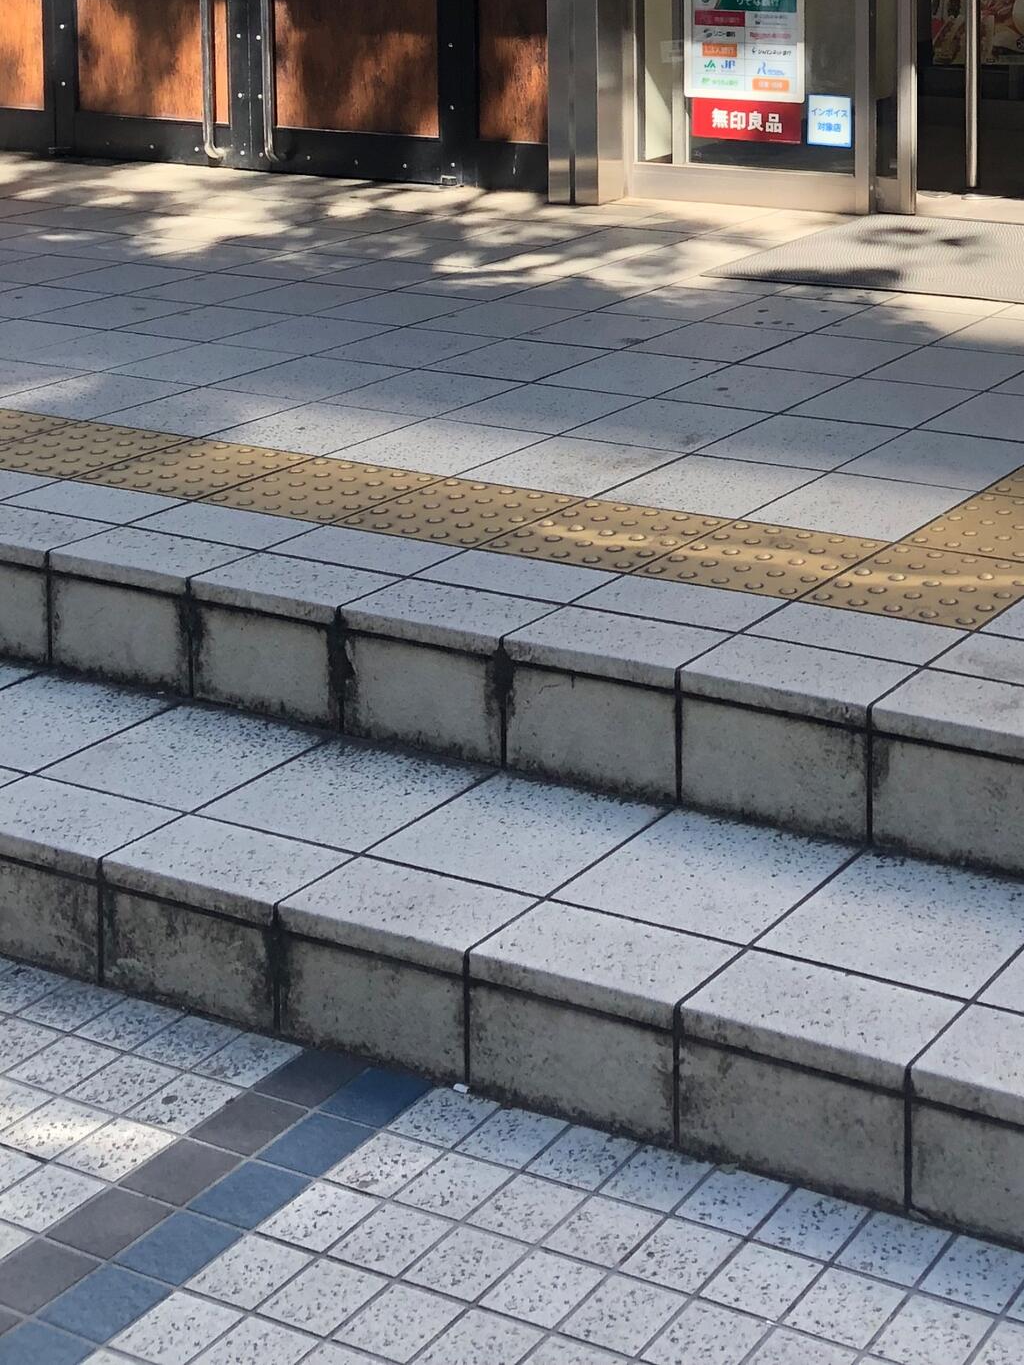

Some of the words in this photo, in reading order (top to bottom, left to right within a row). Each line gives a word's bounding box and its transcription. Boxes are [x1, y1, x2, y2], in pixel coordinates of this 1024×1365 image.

[810, 107, 848, 118] インボイス
[711, 108, 783, 134] 無印良品
[816, 121, 842, 133] 対象店
